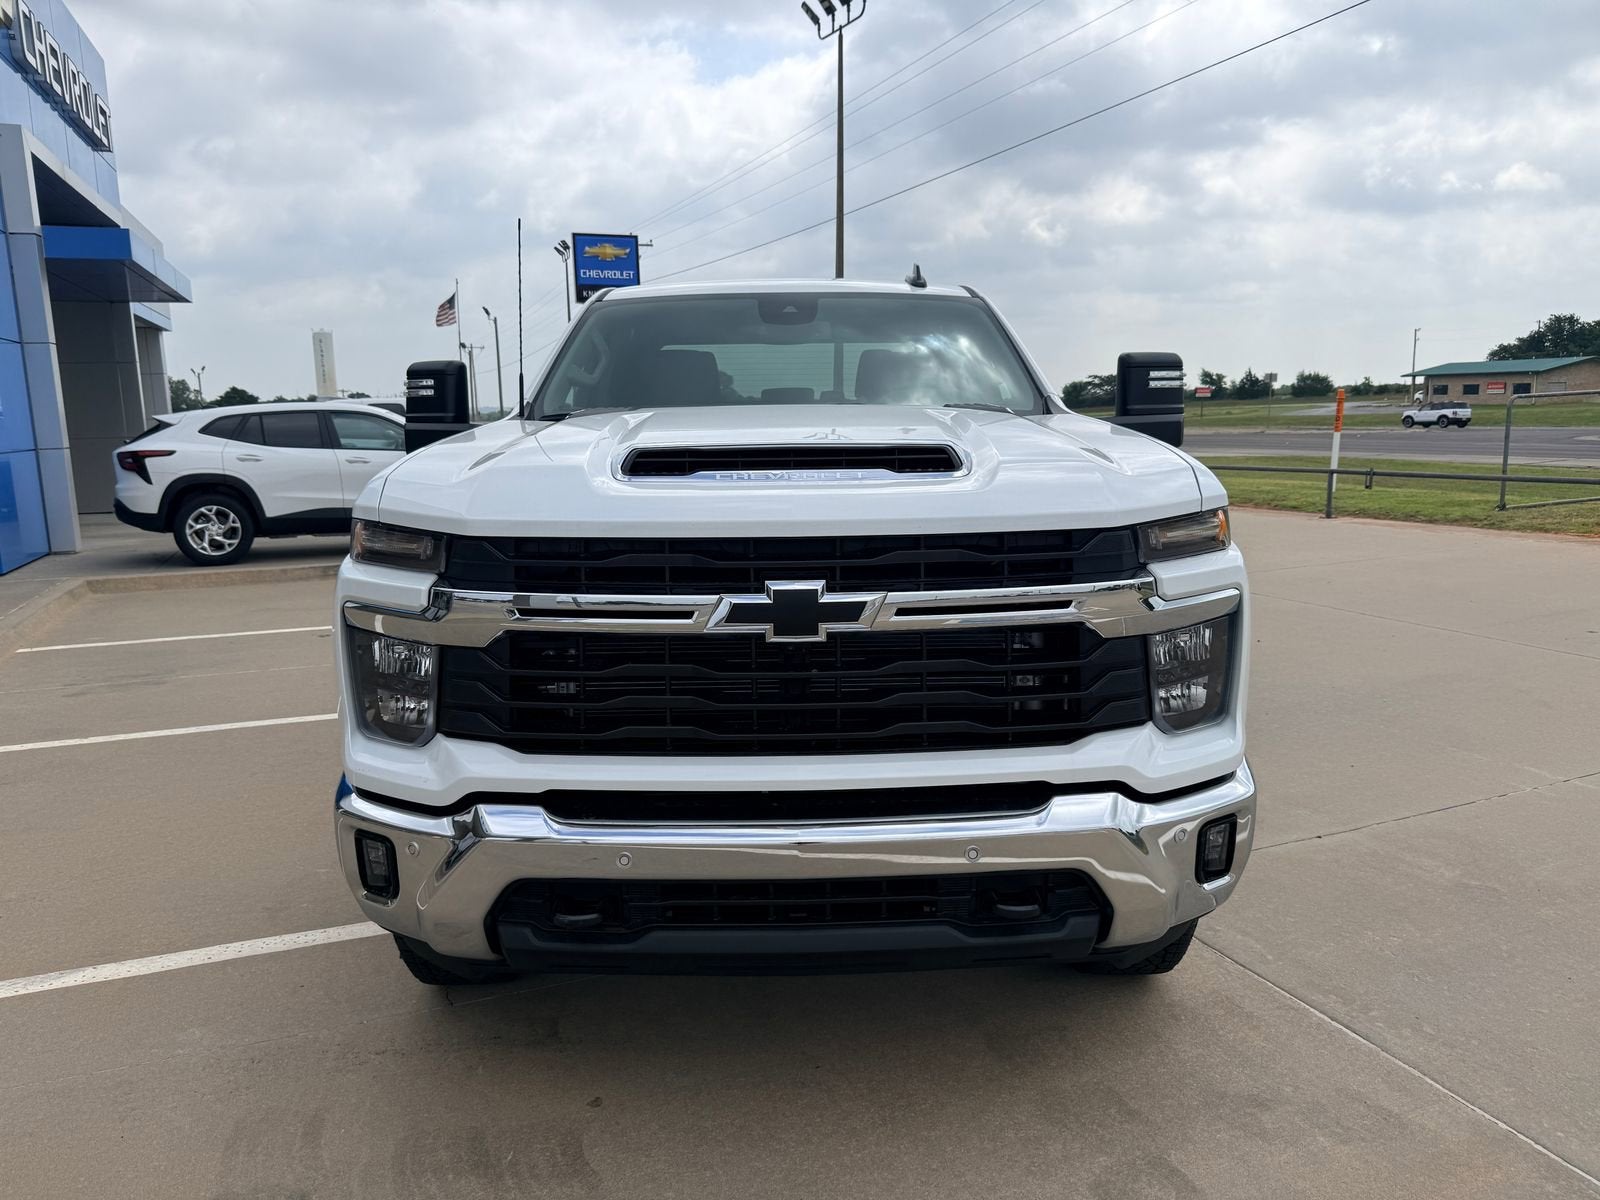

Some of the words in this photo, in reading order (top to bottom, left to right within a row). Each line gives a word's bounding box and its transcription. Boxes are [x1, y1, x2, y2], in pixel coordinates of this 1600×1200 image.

[16, 0, 113, 152] CHEVROLET
[580, 269, 635, 279] CHEVROLET
[715, 471, 863, 481] CHEVROLET
